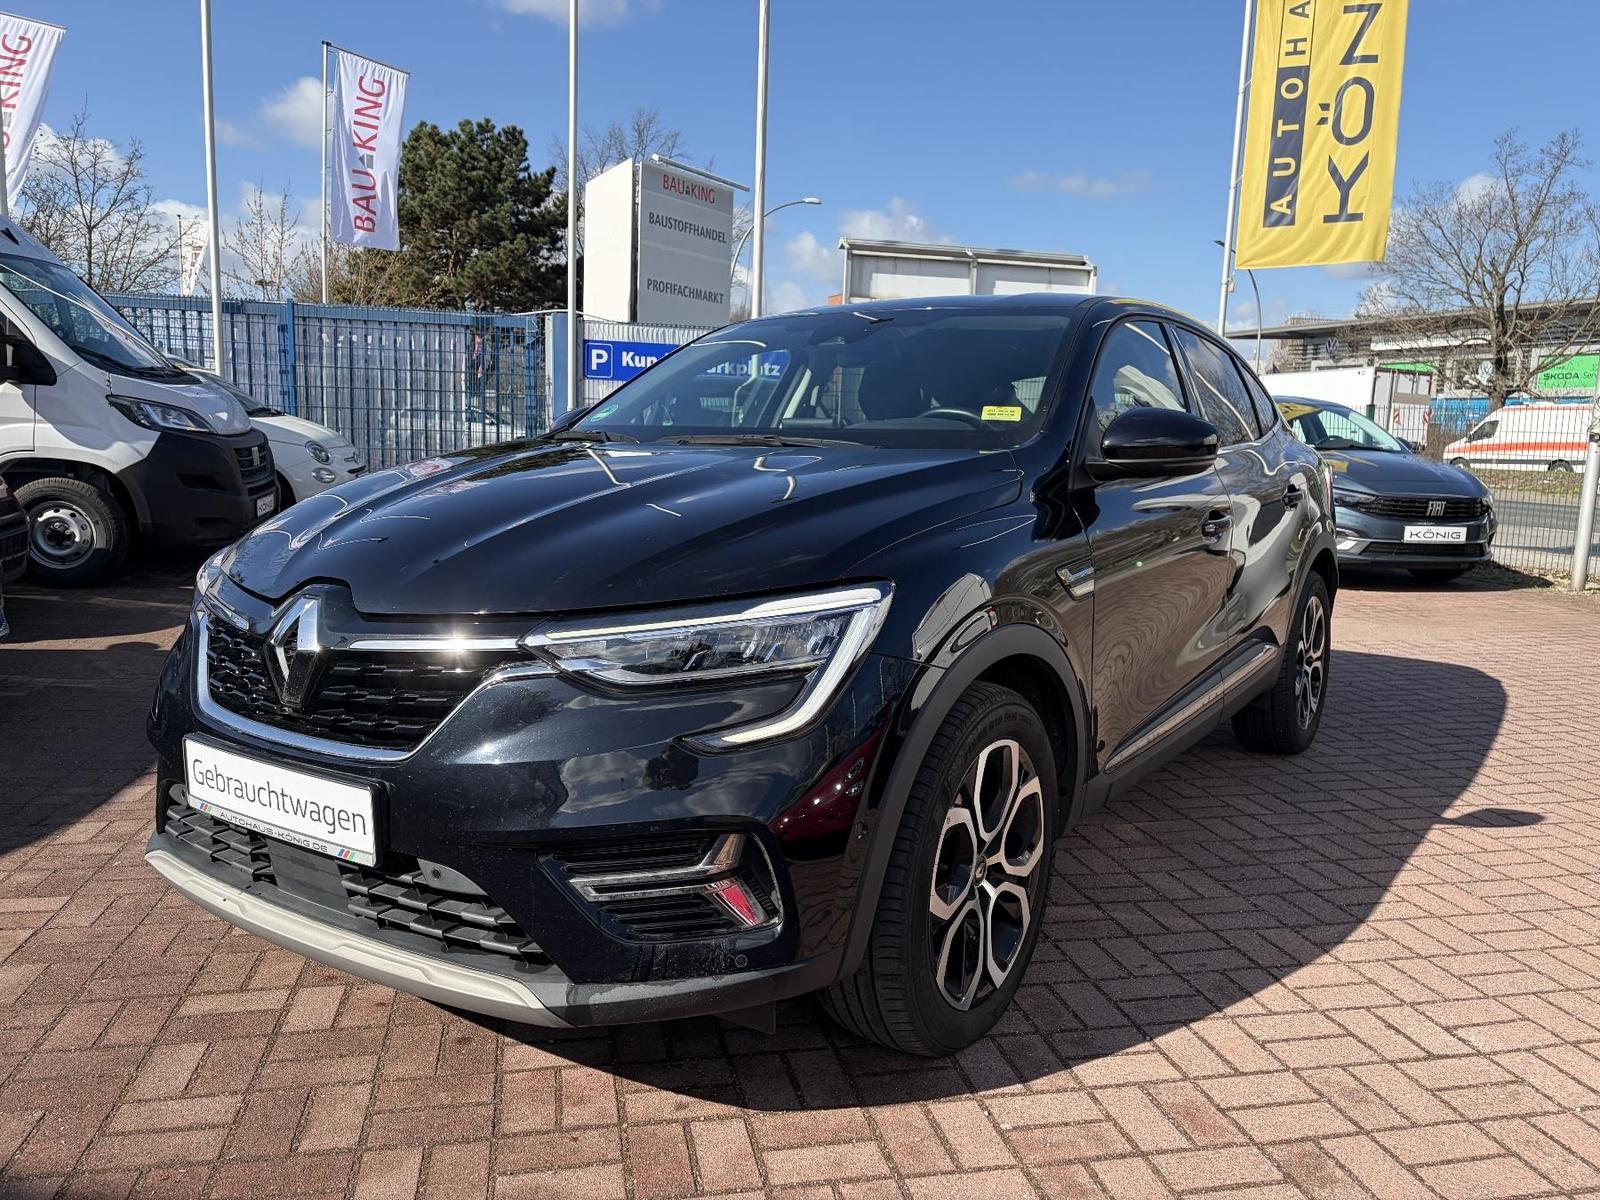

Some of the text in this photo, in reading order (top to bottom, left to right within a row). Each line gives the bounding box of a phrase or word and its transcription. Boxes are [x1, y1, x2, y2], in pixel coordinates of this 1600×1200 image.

[352, 75, 386, 233] BAU KING
[662, 174, 716, 205] BAU KING
[648, 211, 727, 244] BAUSTOFFHANDEL
[646, 278, 725, 305] PROFIFACHMARKT
[1425, 501, 1447, 517] FIAT
[1409, 528, 1462, 540] KÖNIG
[192, 758, 367, 836] Gebrauchtwagen
